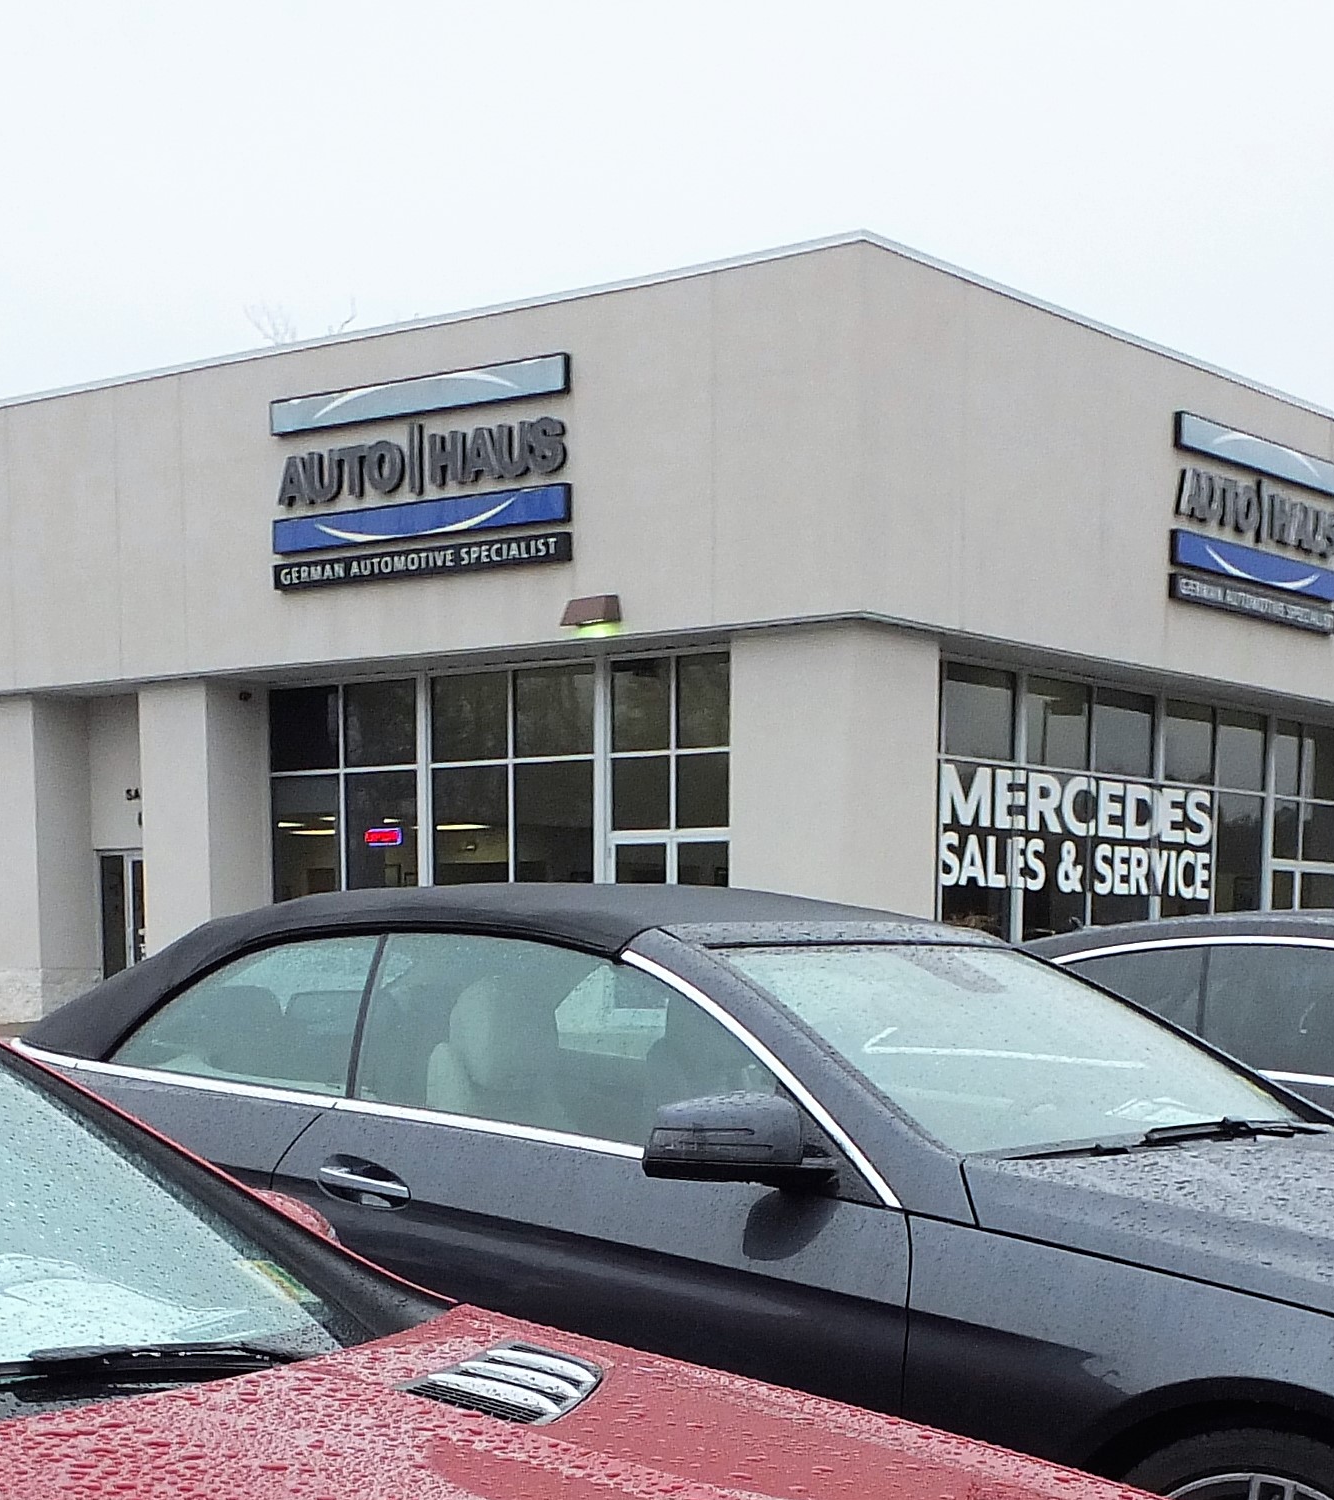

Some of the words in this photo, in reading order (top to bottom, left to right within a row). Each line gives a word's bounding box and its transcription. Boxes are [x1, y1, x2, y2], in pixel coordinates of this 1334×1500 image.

[280, 562, 344, 586] GERMAN
[349, 549, 455, 577] AUTOMOTIVE
[459, 535, 557, 566] SPECIALIST
[126, 787, 141, 801] SA
[940, 764, 1213, 847] MERCEDES
[940, 831, 1045, 891] SALES
[1056, 840, 1083, 893] &
[1094, 843, 1210, 900] SERVICE
